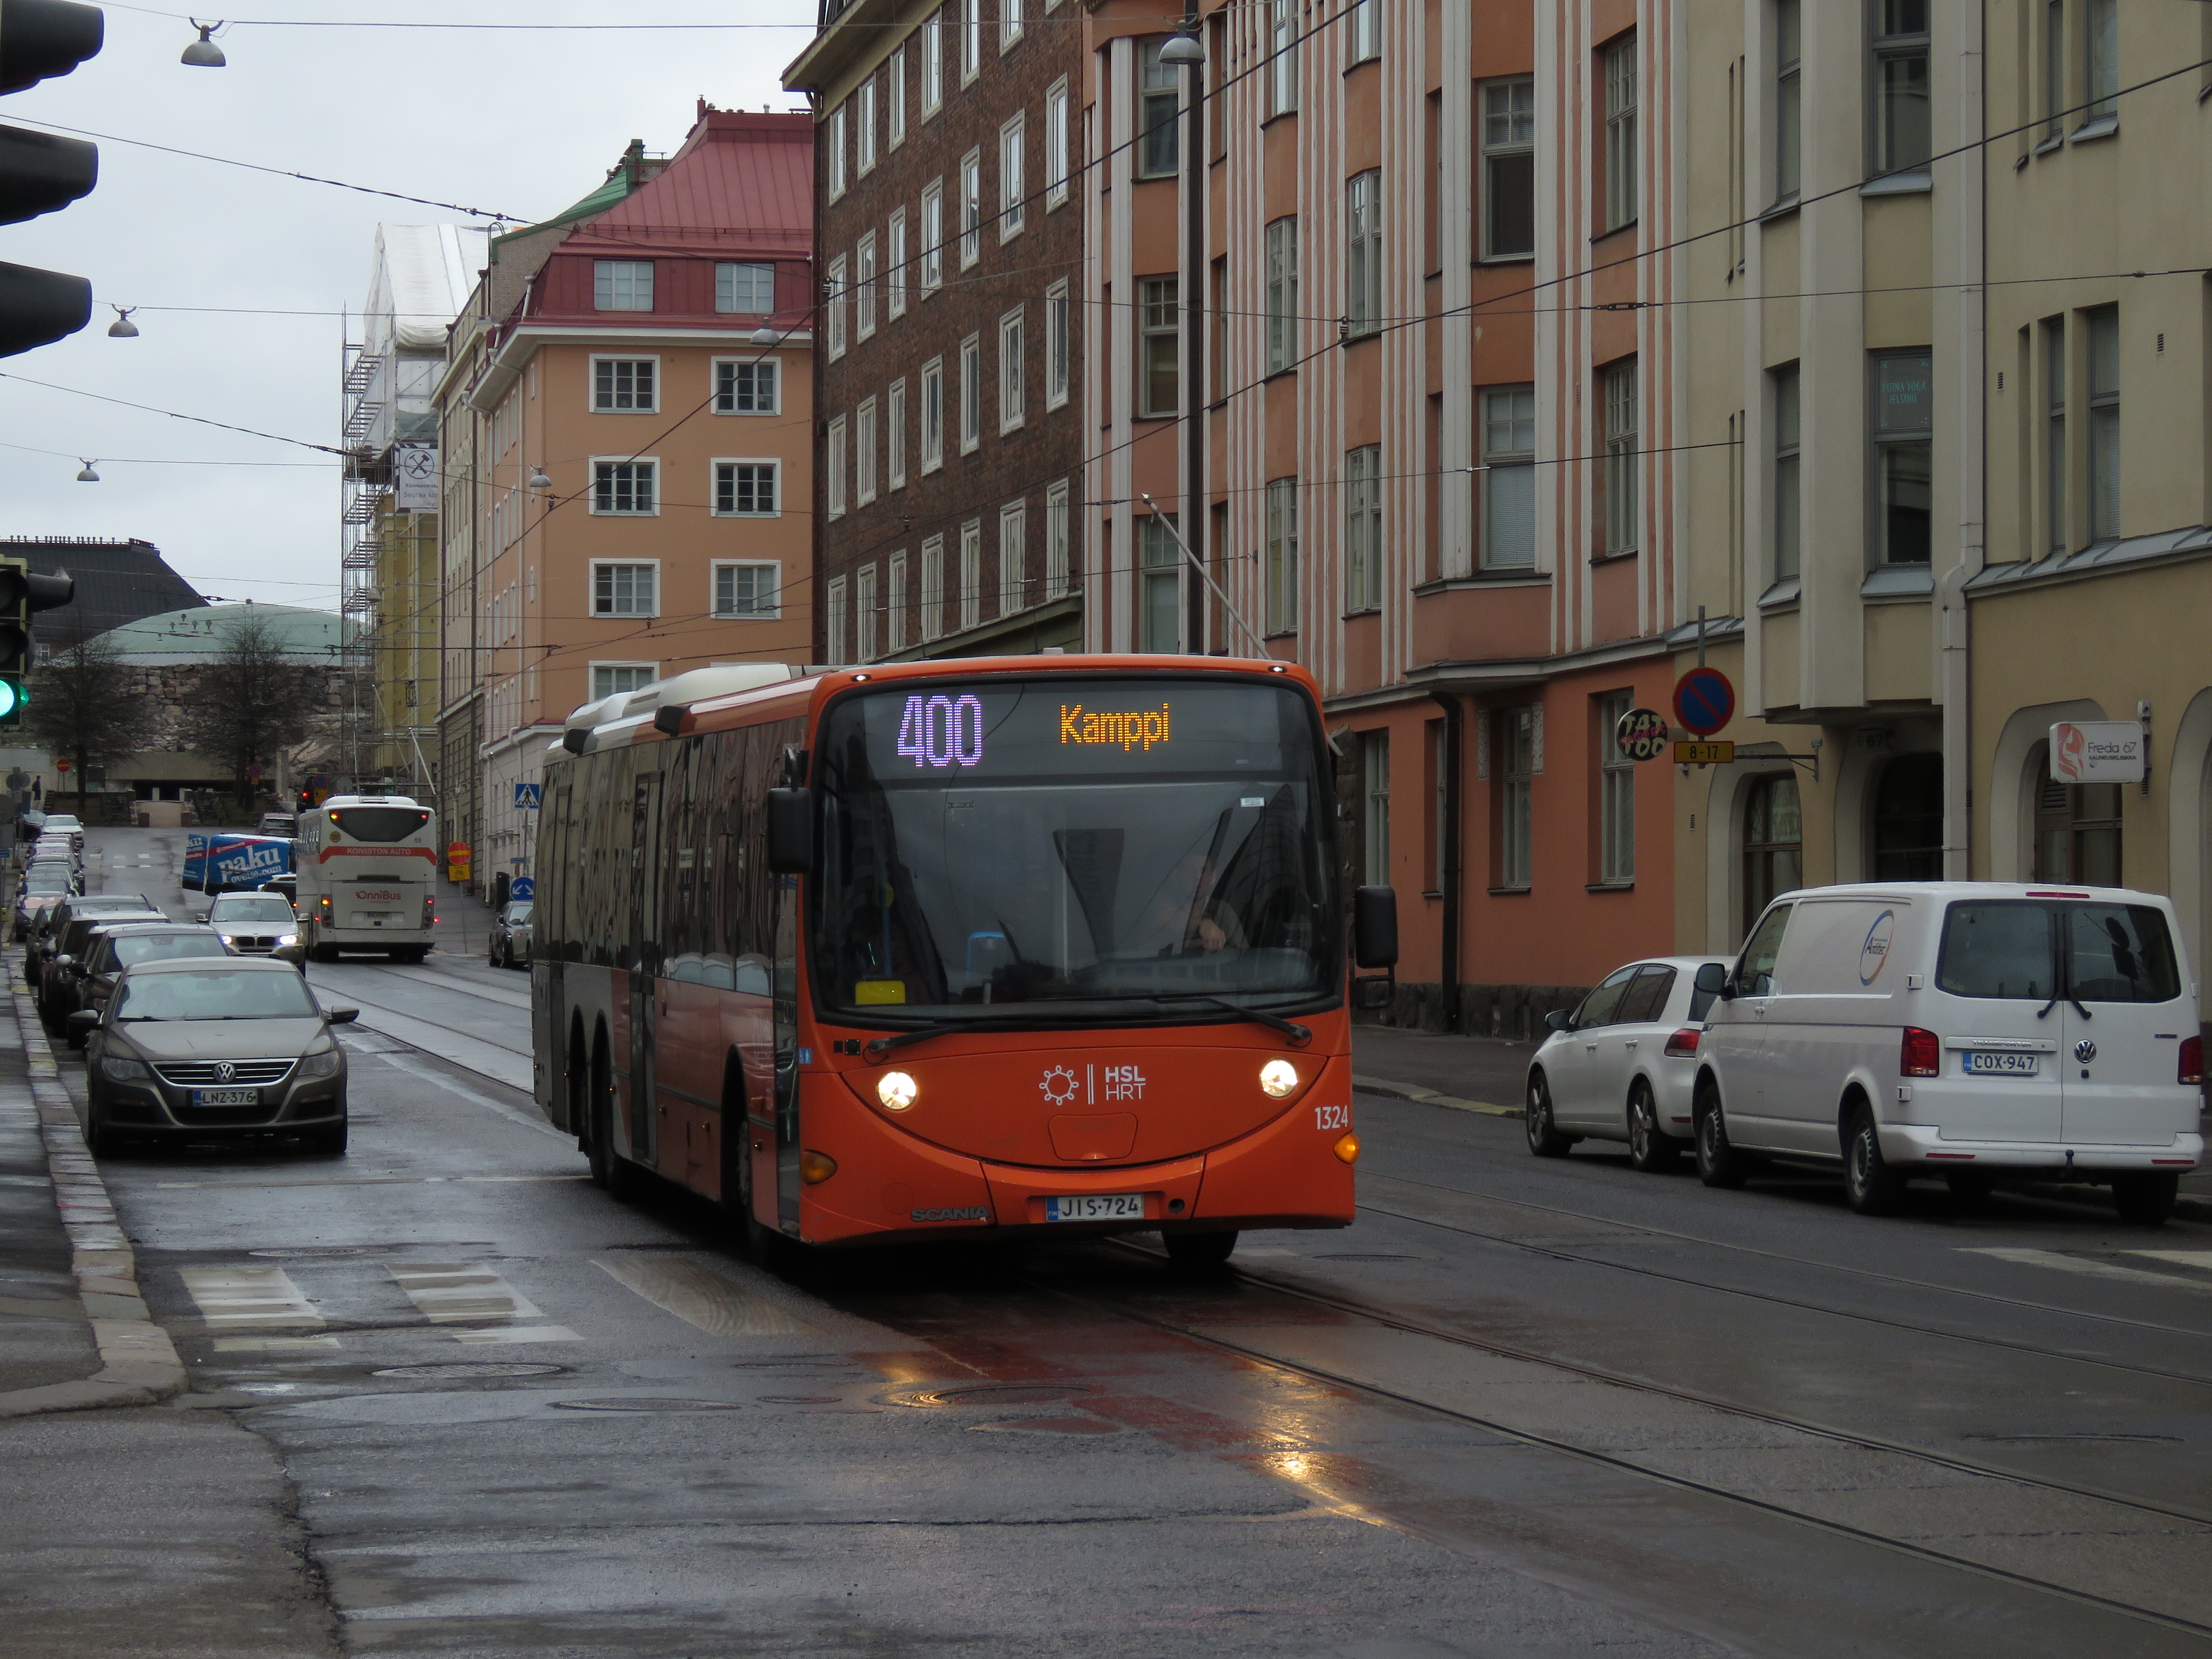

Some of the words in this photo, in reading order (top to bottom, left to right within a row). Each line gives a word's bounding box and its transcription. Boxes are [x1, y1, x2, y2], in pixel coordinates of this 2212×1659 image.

[1907, 381, 1926, 391] YOGA
[897, 695, 982, 767] 400
[1060, 703, 1169, 751] Kamppi
[1623, 714, 1663, 735] TAT
[1867, 734, 1883, 747] 67
[2088, 742, 2119, 753] Freda
[2123, 742, 2137, 753] 67
[218, 844, 281, 885] paku
[355, 890, 401, 900] OnniBus
[1974, 1055, 2035, 1070] COX-947
[1105, 1066, 1146, 1082] HSL
[202, 1092, 254, 1103] LNZ-376
[1106, 1083, 1146, 1101] HRT
[1314, 1105, 1348, 1130] 1324
[911, 1205, 991, 1222] SCANIA
[1062, 1198, 1139, 1217] JIS-724
